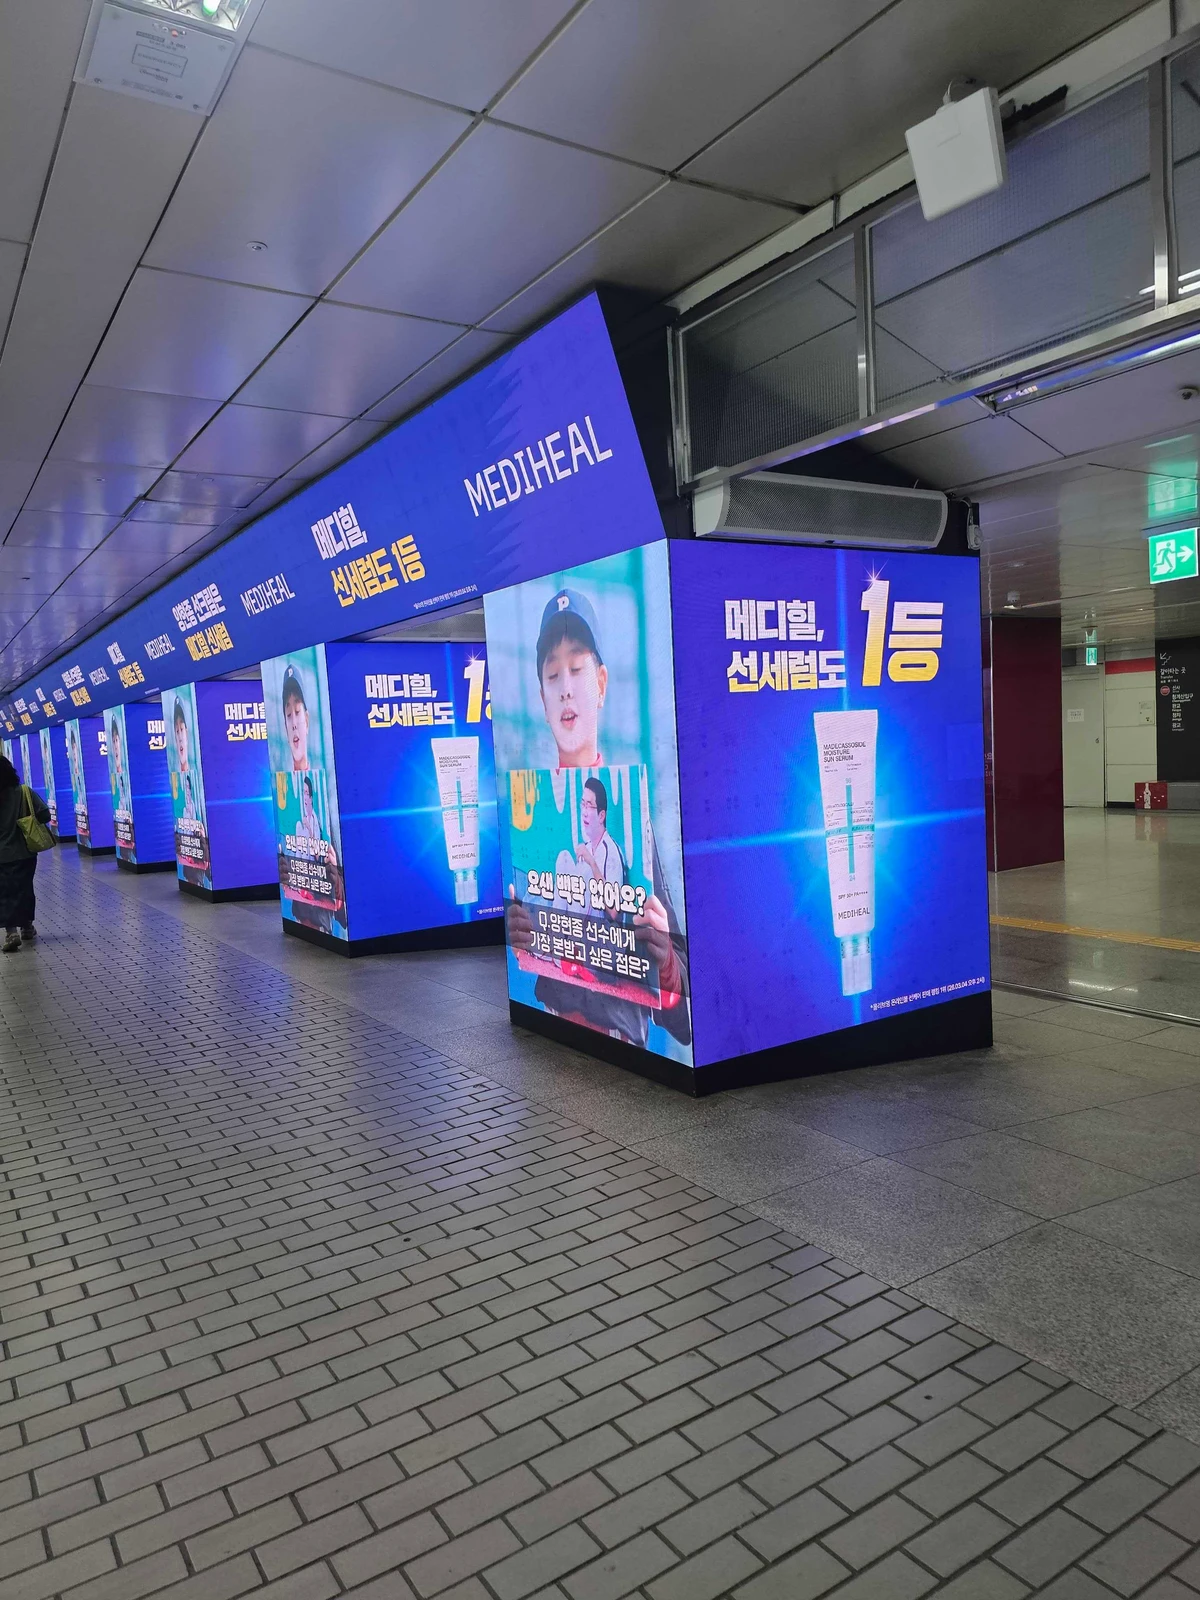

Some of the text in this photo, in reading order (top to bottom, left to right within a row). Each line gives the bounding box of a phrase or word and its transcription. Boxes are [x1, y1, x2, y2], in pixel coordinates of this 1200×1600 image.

[463, 415, 613, 517] MEDIHEAL
[311, 503, 368, 560] 메디힐,
[330, 548, 399, 608] 선세럼도
[391, 535, 426, 584] 1등
[240, 573, 296, 617] MEDIHEAL
[557, 596, 569, 611] P
[725, 599, 824, 642] 메디힐,
[861, 579, 944, 687] 1등
[365, 674, 438, 699] 메디힐,
[464, 659, 492, 723] 1
[727, 650, 846, 693] 선세럼도
[368, 702, 455, 728] 선세럼도
[527, 869, 646, 917] 요샌 백탁 없어요?
[838, 907, 871, 920] MEDIHEAL
[538, 911, 636, 952] Q.양현종 선수에게
[530, 930, 650, 979] 가장 본받고 싶은 점은?
